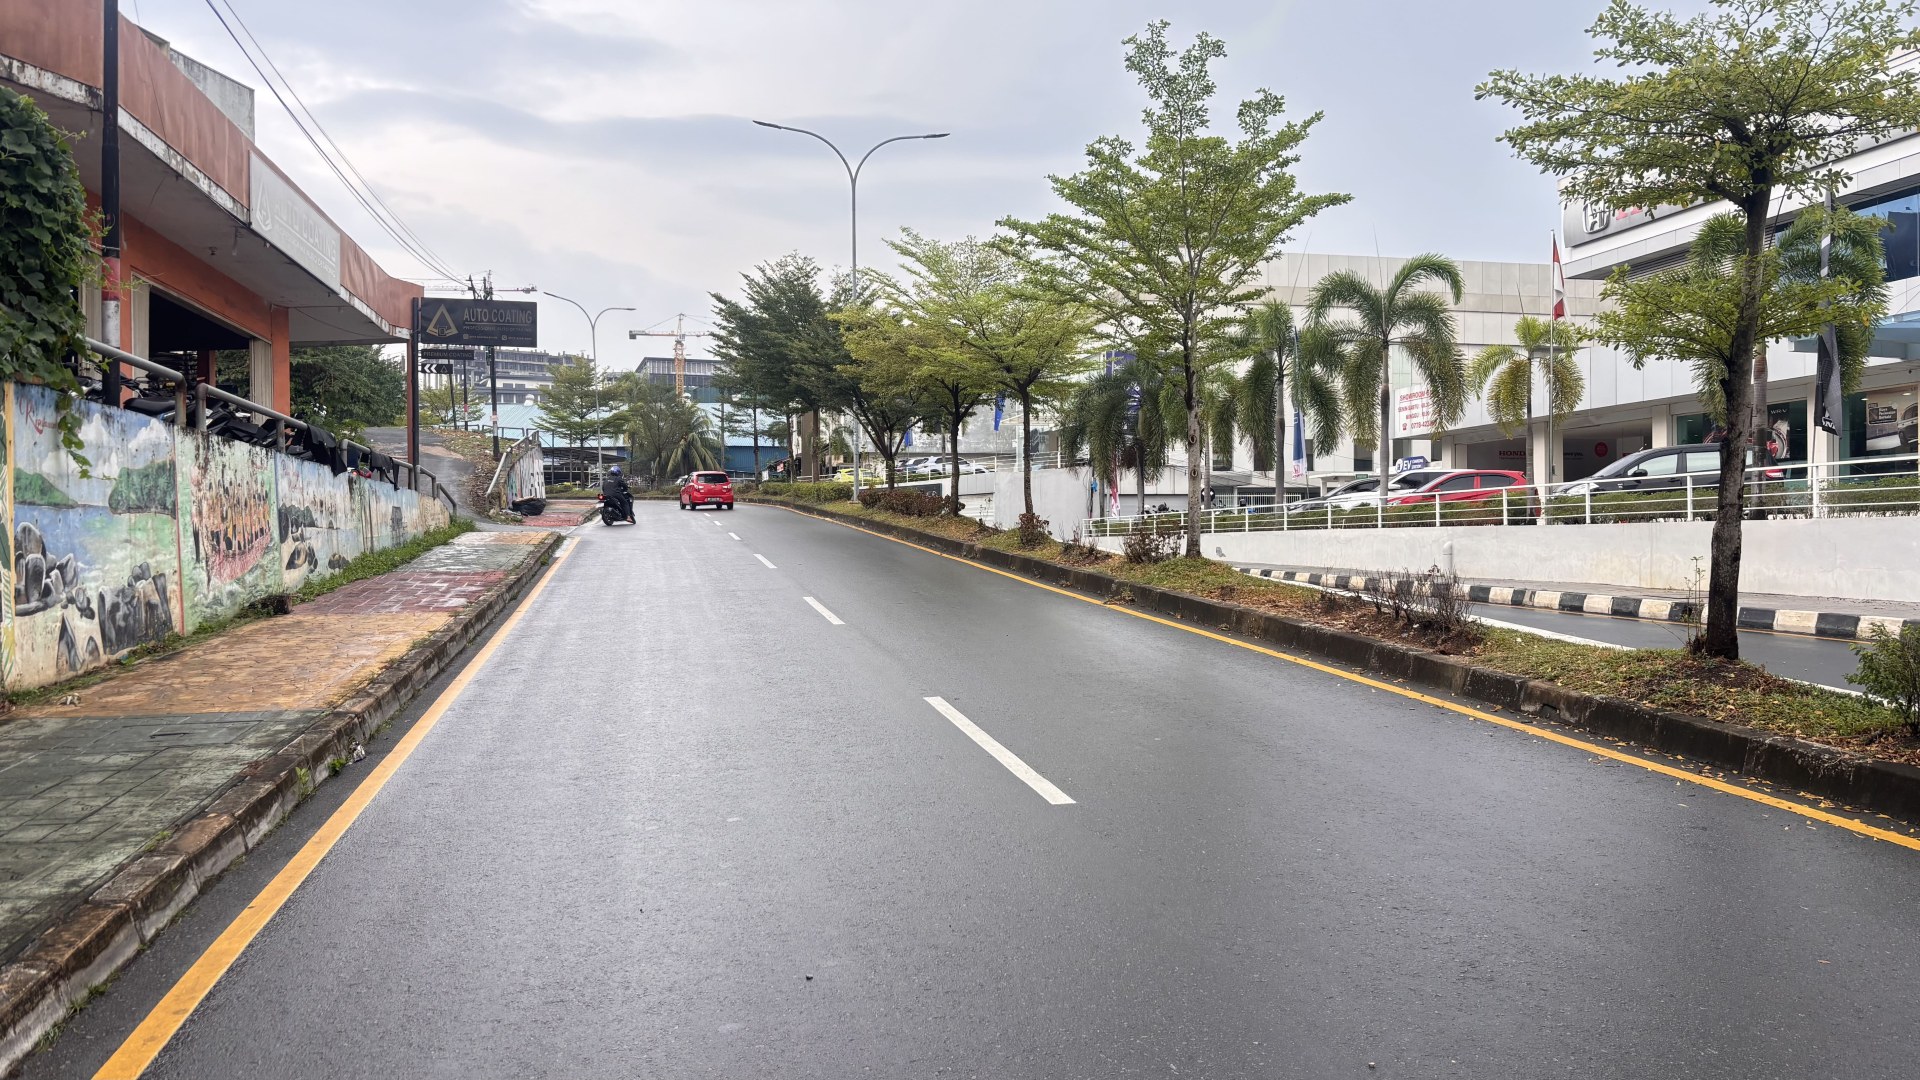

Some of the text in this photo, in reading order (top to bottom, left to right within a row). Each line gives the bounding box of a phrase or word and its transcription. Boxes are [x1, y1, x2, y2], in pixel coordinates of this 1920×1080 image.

[302, 214, 335, 262] COATING
[463, 308, 532, 324] AUTO COATING
[1403, 460, 1412, 471] EV
